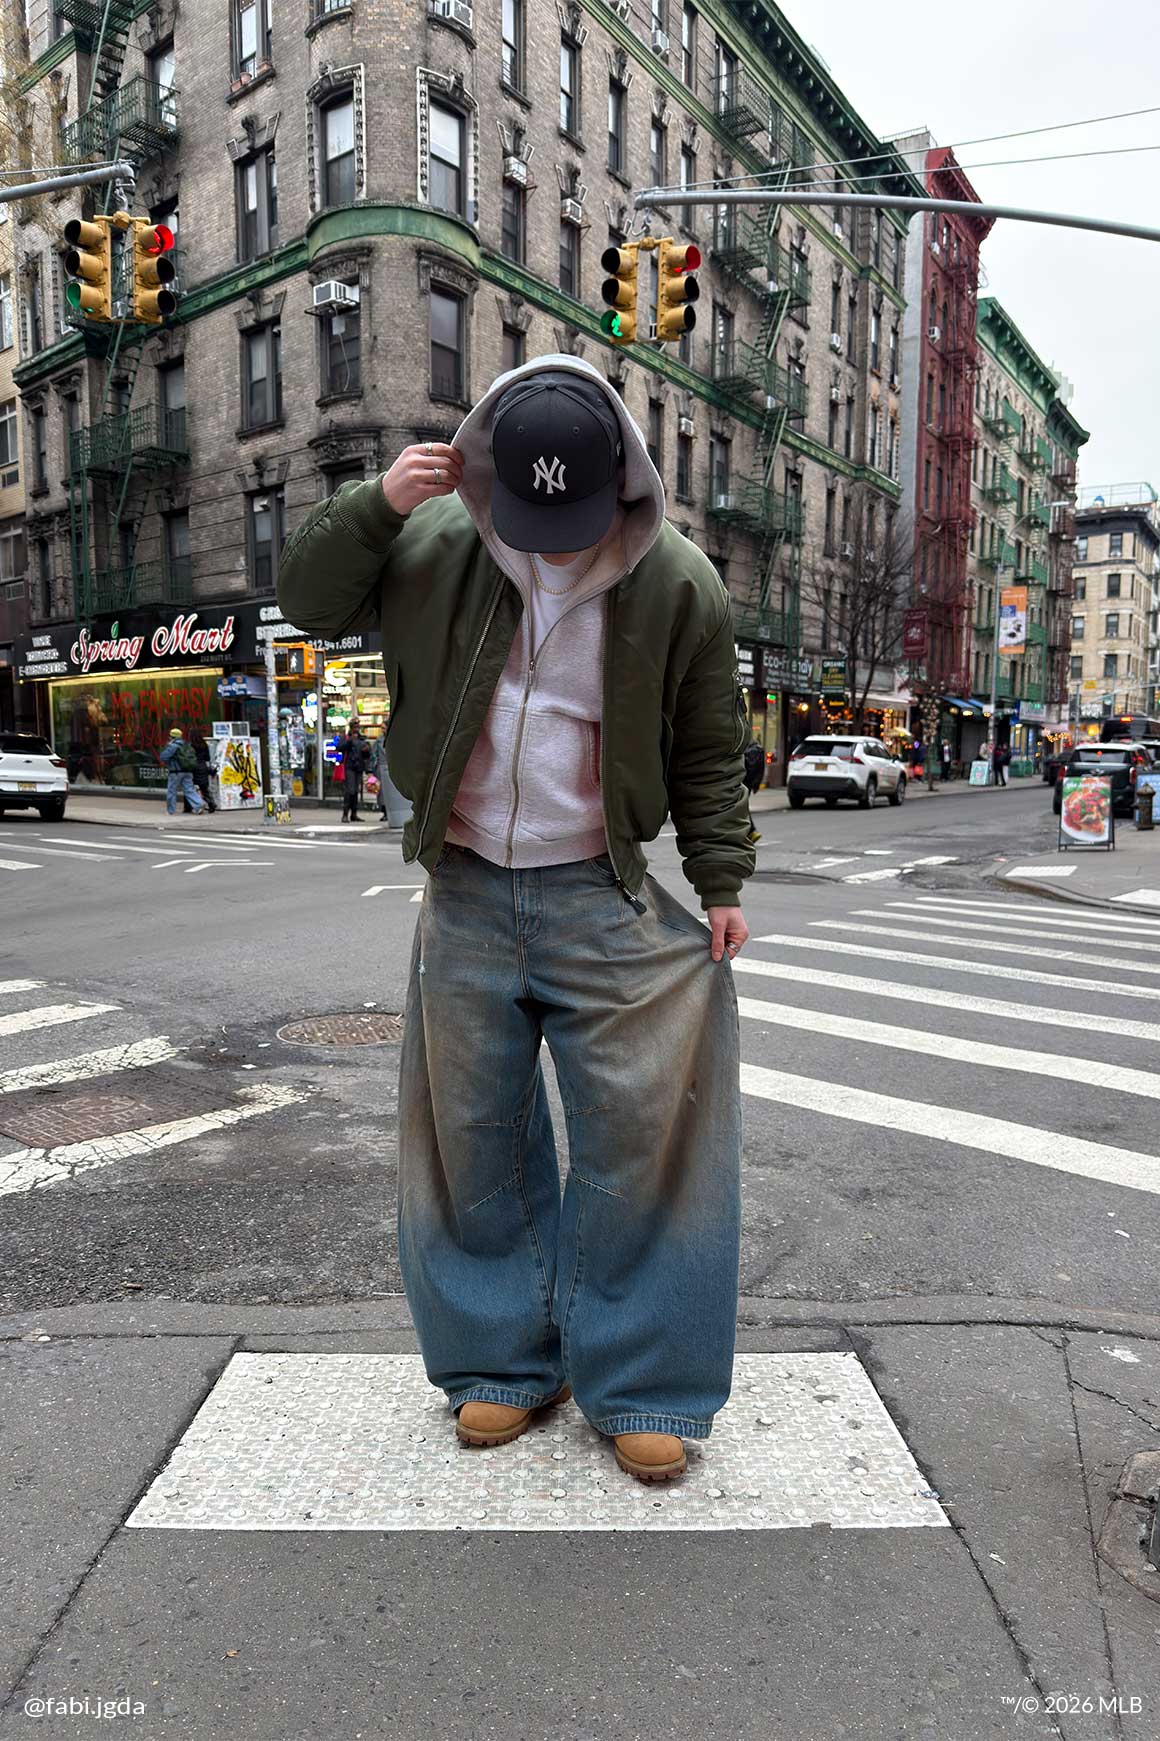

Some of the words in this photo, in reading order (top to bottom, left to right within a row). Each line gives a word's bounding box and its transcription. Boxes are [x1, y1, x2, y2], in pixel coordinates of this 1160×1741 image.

[532, 456, 567, 494] NY
[71, 624, 145, 672] Spring
[152, 613, 235, 656] Mart
[139, 687, 212, 720] FANTASY
[139, 767, 169, 777] FEBRUAR
